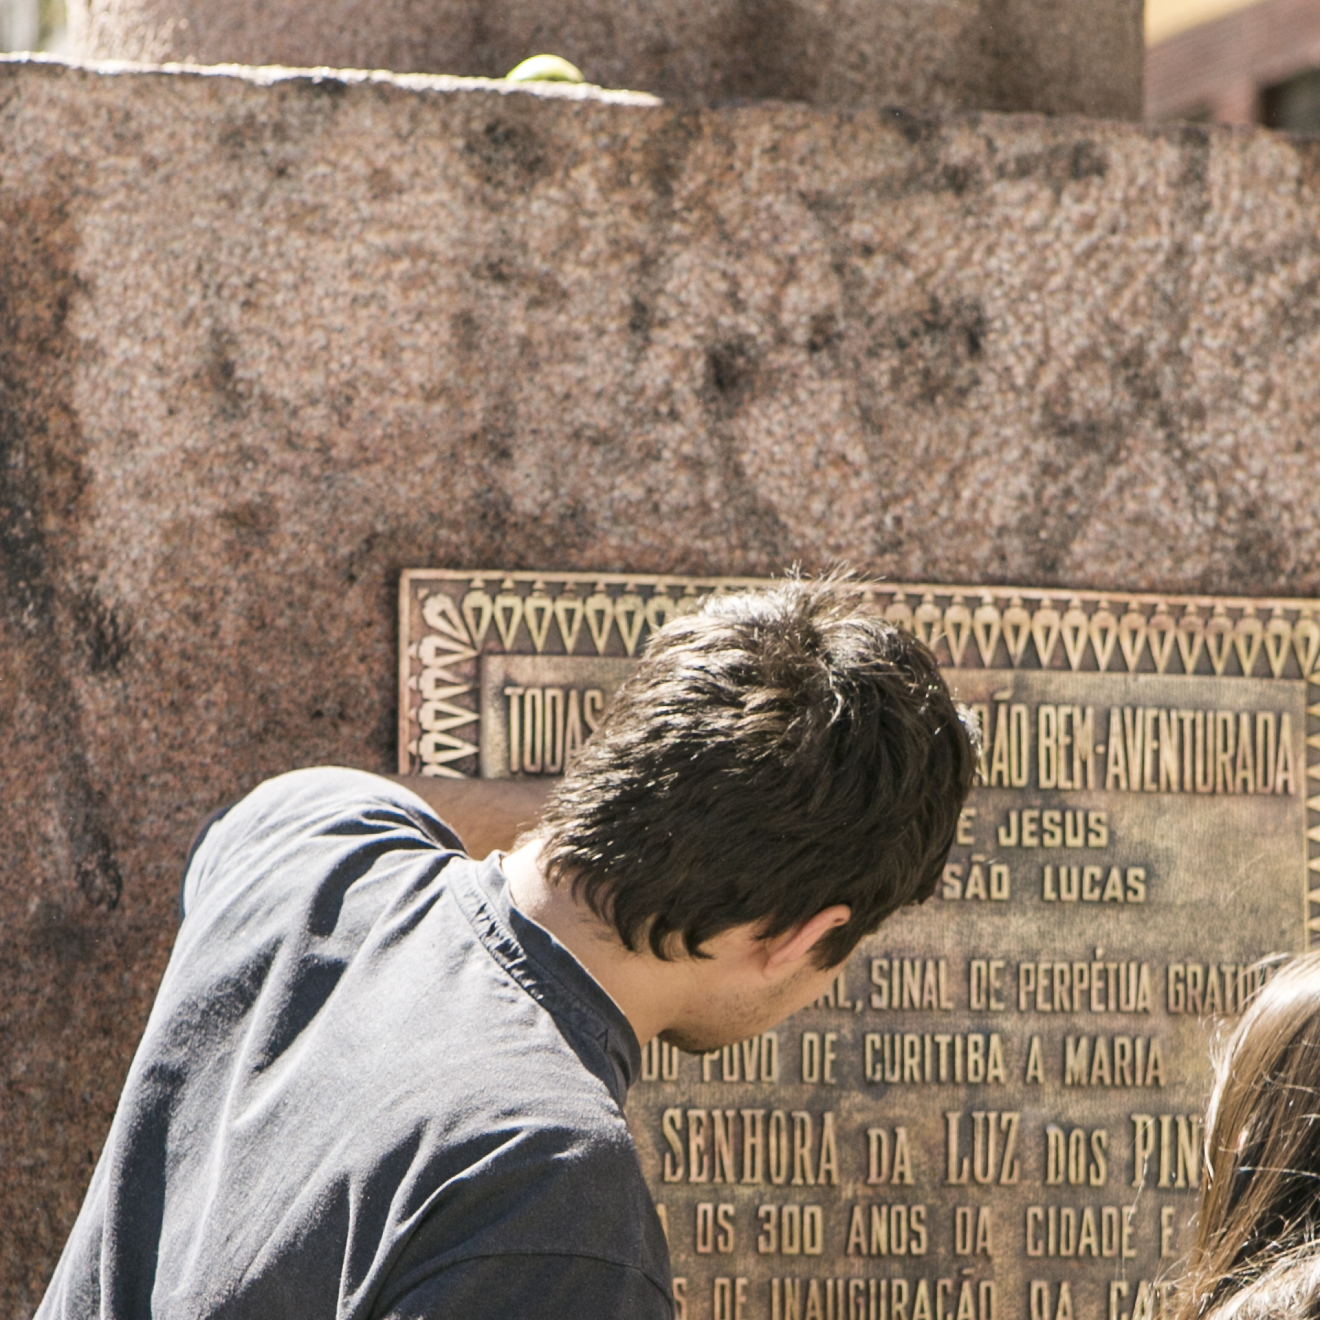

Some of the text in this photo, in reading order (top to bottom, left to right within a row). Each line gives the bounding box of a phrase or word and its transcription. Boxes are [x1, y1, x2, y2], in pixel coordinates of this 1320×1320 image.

[998, 810, 1109, 848] JESUS
[942, 855, 1147, 903] SÃO LUCAS
[871, 959, 954, 1011] SINAL
[970, 960, 1006, 1012] DE
[1019, 946, 1151, 1014] PERPÉTUA
[802, 1032, 837, 1084] DE
[864, 1033, 1005, 1084] CURITIBA
[1025, 1034, 1044, 1084] A
[1065, 1035, 1165, 1086] MARIA
[662, 1109, 839, 1186] SENHORA
[867, 1127, 915, 1186] DA
[944, 1111, 1020, 1186] LUZ
[1046, 1127, 1107, 1187] DOS
[697, 1203, 735, 1253] OS
[758, 1204, 822, 1255] 300
[848, 1205, 927, 1255] ANOS
[955, 1206, 991, 1256] DA
[1027, 1206, 1137, 1258] CIDADE
[1161, 1206, 1176, 1257] E
